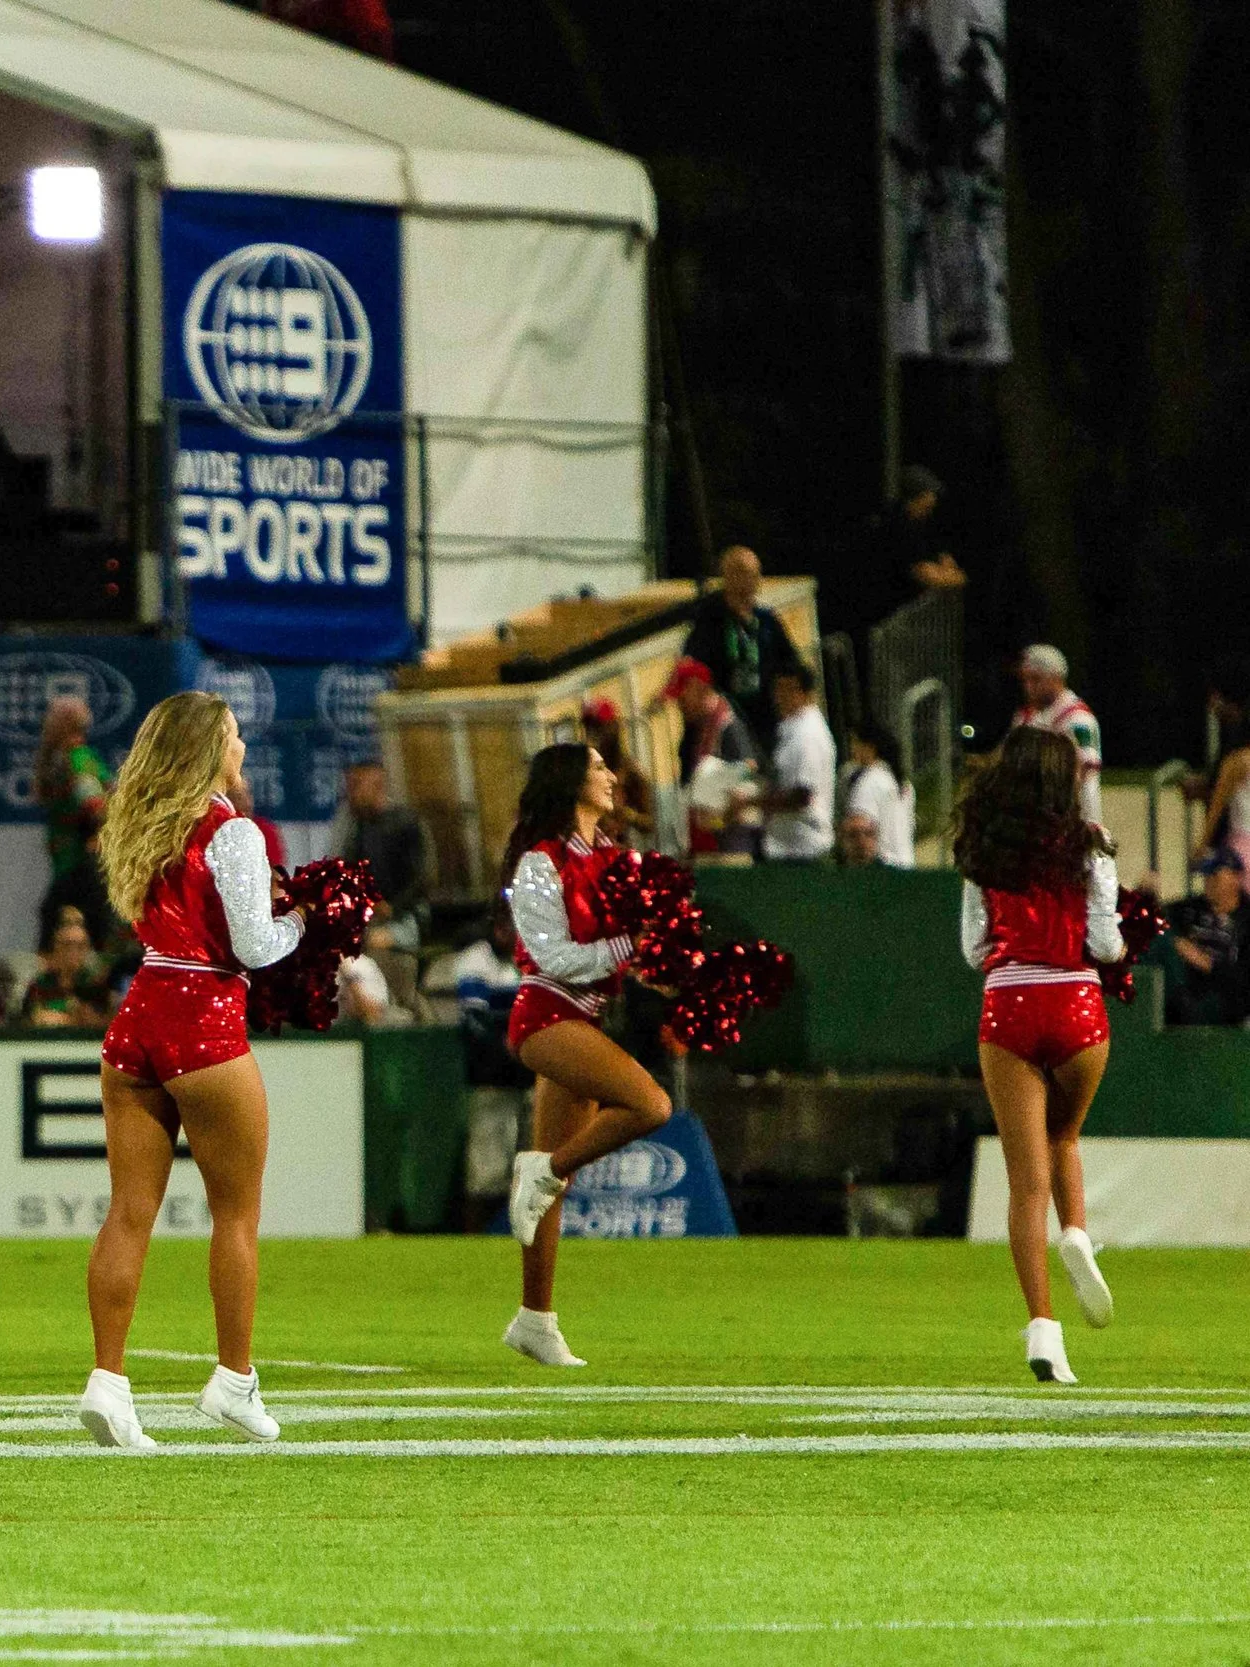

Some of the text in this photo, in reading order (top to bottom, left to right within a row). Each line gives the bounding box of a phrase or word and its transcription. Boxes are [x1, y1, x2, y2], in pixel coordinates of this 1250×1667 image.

[174, 450, 389, 500] WIDE WORLD OF
[174, 495, 392, 587] SPORTS
[561, 1204, 687, 1237] PORTS
